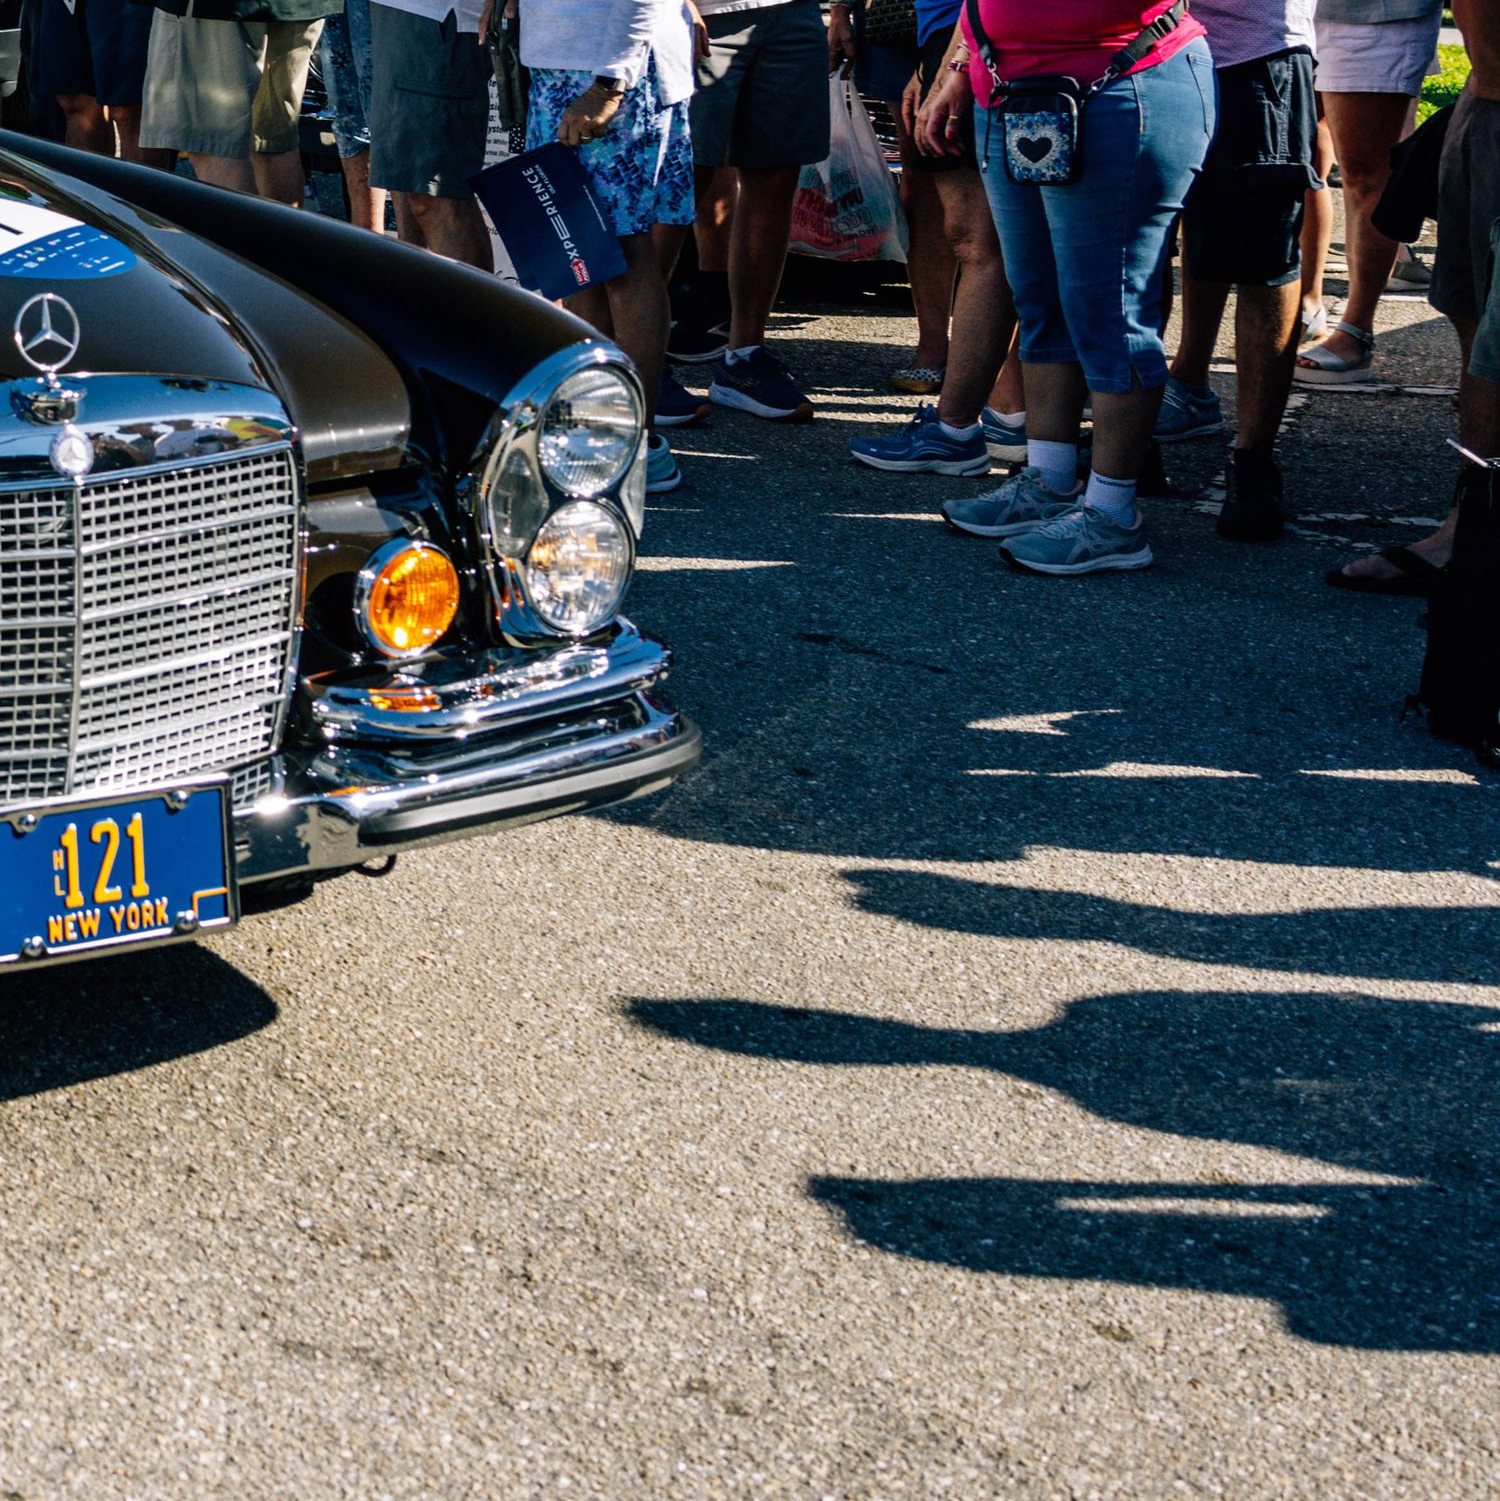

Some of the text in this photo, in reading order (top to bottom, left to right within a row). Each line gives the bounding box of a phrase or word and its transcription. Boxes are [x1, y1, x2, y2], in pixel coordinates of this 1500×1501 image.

[521, 167, 581, 261] XPERIENCE
[61, 811, 150, 909] 121
[48, 896, 169, 943] NEW YORK
